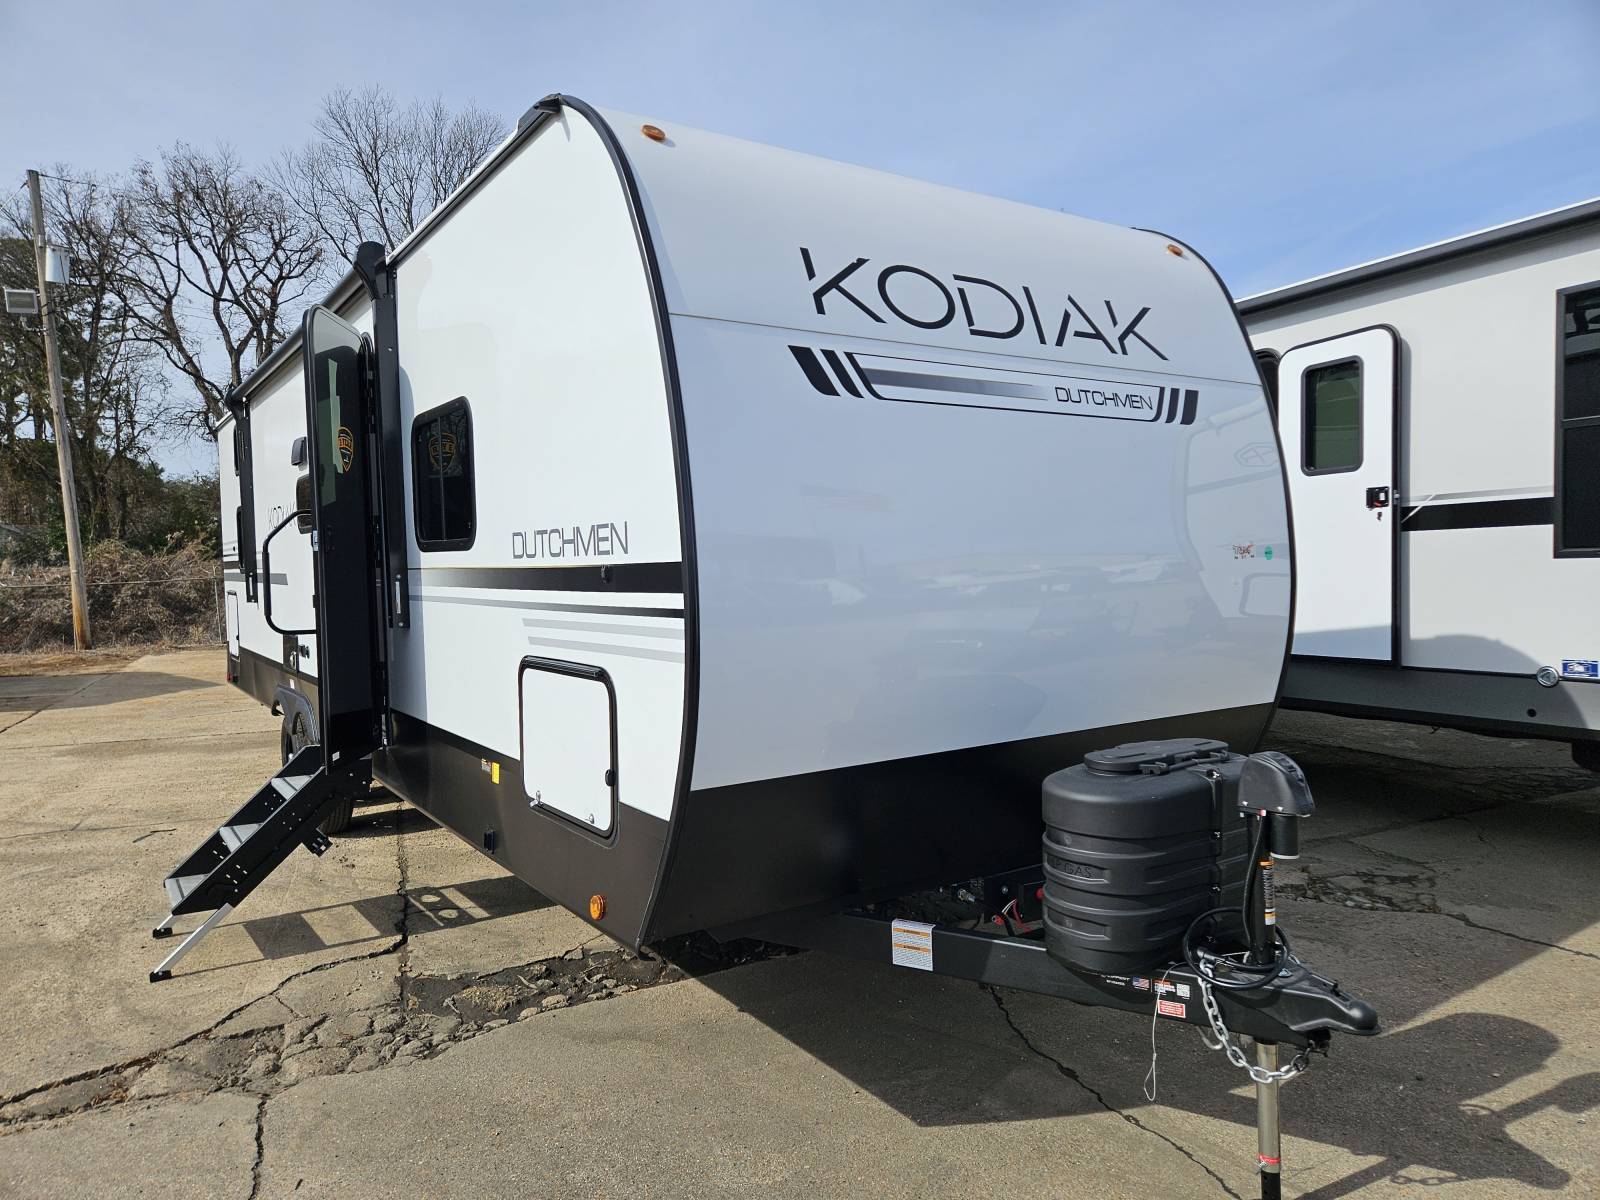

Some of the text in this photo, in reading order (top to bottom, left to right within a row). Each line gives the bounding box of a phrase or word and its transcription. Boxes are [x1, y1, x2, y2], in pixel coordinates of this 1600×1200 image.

[800, 247, 1170, 361] KODIAK
[1054, 386, 1153, 410] DUTCHMEN
[512, 521, 628, 559] DUTCHMEN
[1064, 863, 1092, 879] GAS
